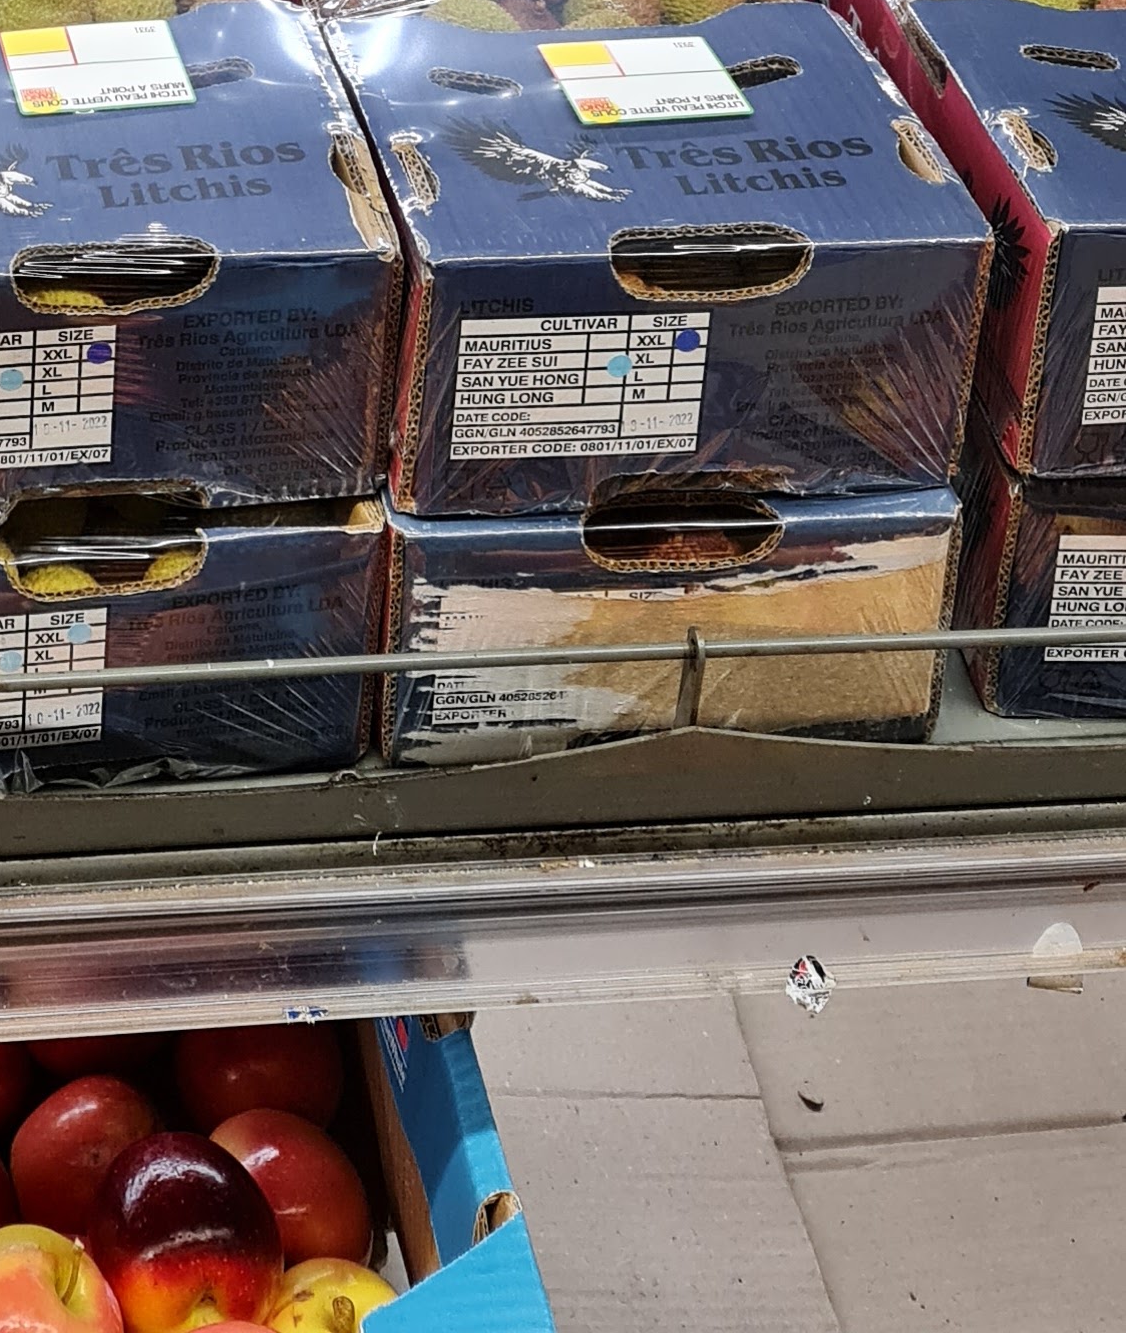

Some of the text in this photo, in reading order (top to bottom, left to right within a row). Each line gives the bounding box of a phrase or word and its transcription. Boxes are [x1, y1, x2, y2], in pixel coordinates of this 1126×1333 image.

[99, 85, 134, 95] POINT
[32, 89, 188, 108] LITCHI PEAU VERTE COLIS
[46, 136, 306, 179] Três Rios
[616, 136, 873, 171] Três Rios
[676, 167, 847, 197] Litchis
[100, 172, 272, 210] Litchis
[541, 315, 688, 331] CULTIVAR SIZE
[58, 329, 94, 342] SIZE
[464, 335, 666, 352] MAURITIUS XXL
[43, 349, 72, 361] XXL
[463, 353, 654, 369] FAY ZEE SUI XL
[42, 367, 62, 378] XL
[462, 373, 579, 387] SAN YUE HONG
[1089, 378, 1121, 388] DATE
[460, 391, 554, 405] HUNG LONG
[456, 412, 531, 423] DATE CODE:
[454, 424, 616, 439] GGN/GLN 4052852647793
[453, 437, 694, 456] EXPORTER CODE: 0801/11/01/EX/07
[1060, 570, 1123, 580] FAY ZEE
[1058, 586, 1123, 596] SAN YUE
[1056, 602, 1100, 612] HUNG
[50, 613, 85, 625] SIZE
[35, 633, 64, 644] XXL
[35, 650, 54, 661] XL
[1047, 649, 1119, 658] EXPORTER
[435, 693, 496, 705] GGN/GLN
